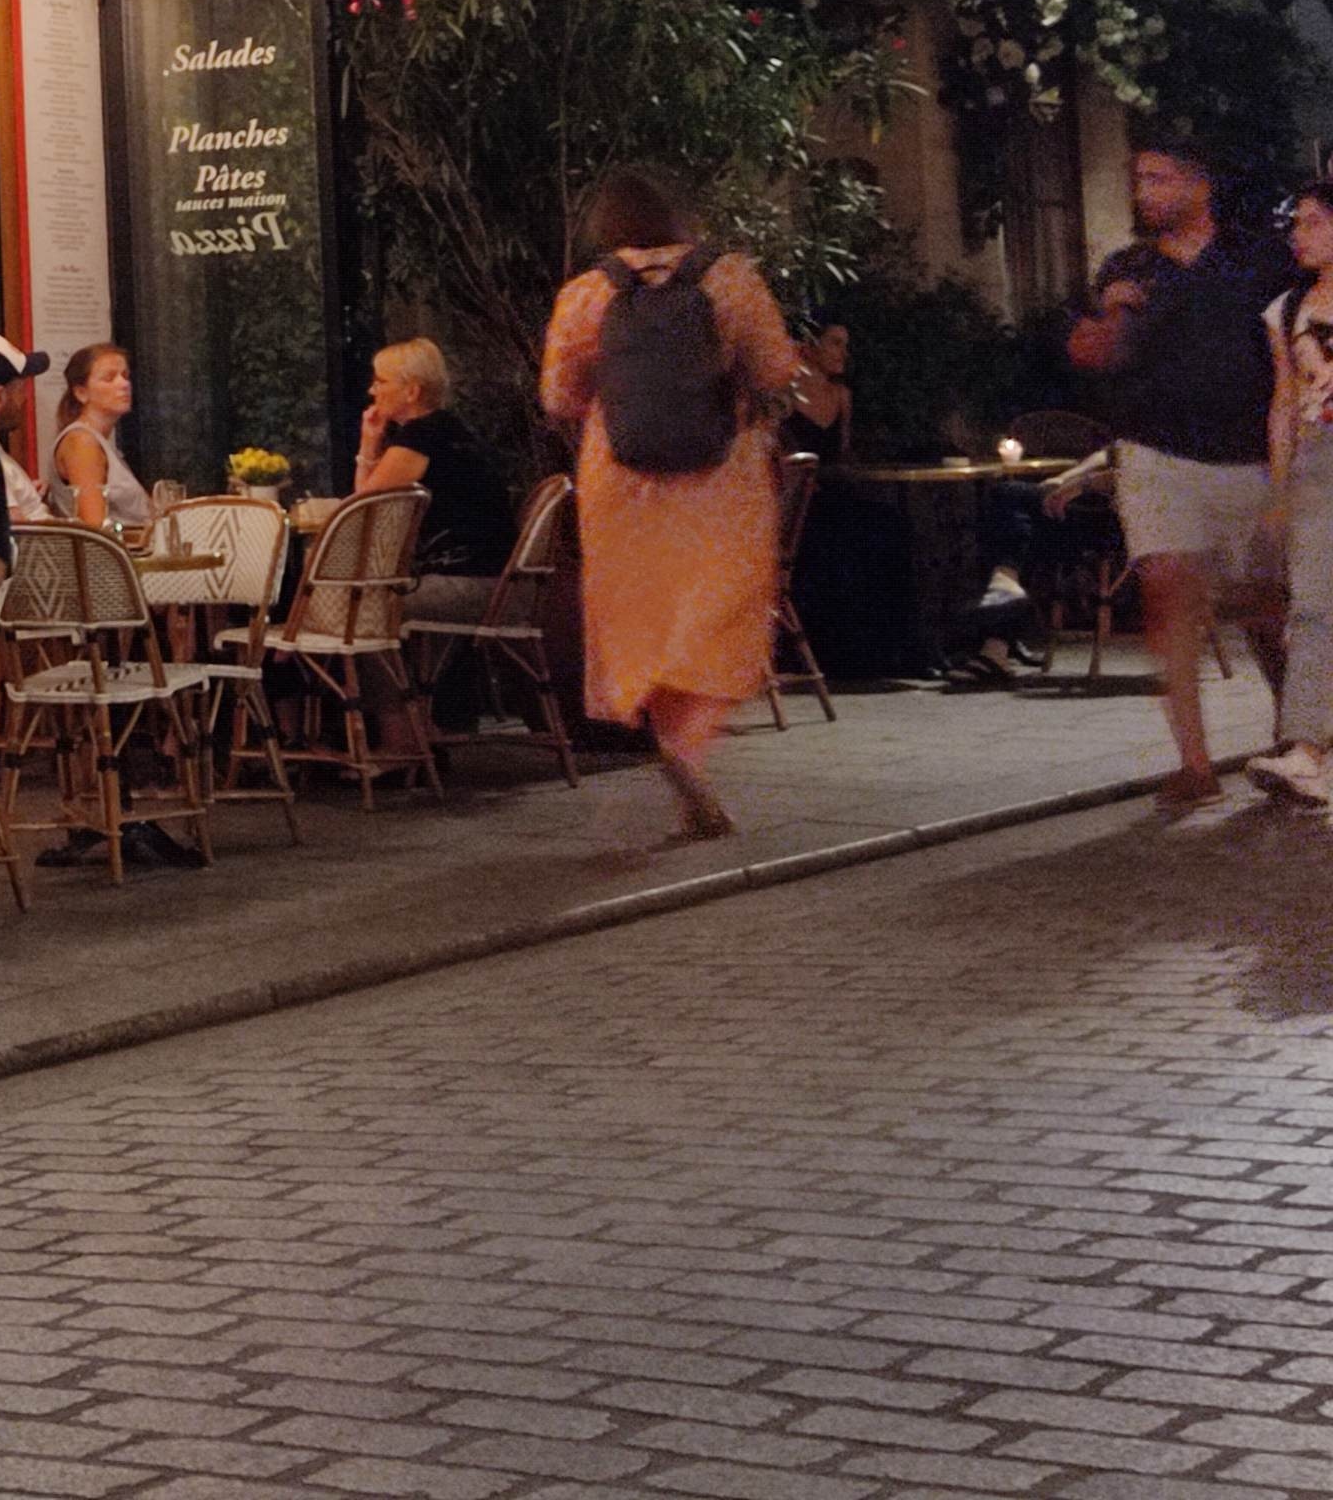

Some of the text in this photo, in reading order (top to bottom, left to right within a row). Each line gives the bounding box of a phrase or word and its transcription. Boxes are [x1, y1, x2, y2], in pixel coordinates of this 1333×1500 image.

[171, 36, 277, 72] Salades
[168, 118, 289, 153] Planches
[195, 164, 267, 192] Pâtes
[175, 193, 287, 212] sauces maison
